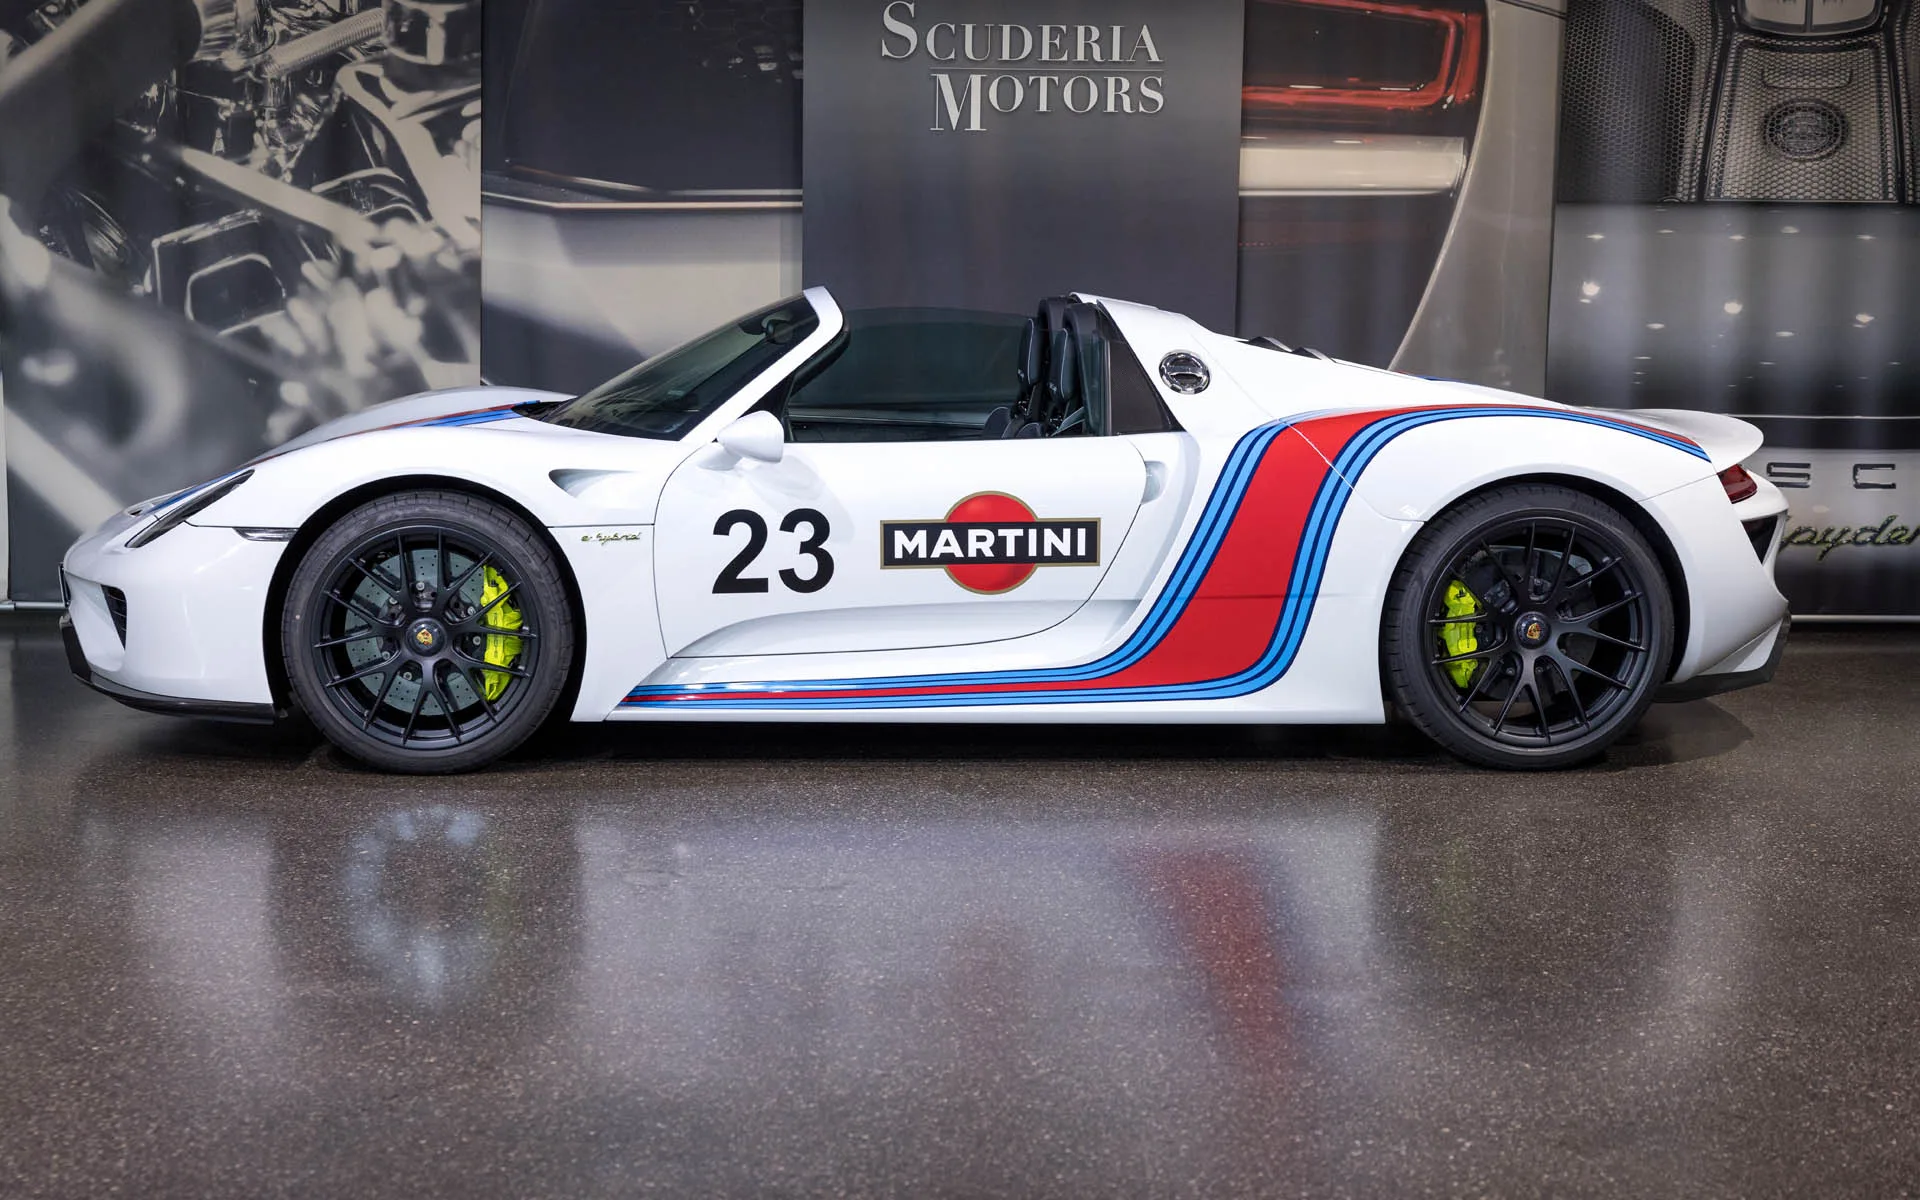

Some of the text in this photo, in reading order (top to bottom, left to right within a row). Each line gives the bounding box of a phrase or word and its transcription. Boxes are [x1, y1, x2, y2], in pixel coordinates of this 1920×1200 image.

[881, 1, 1164, 60] SCUDERIA
[930, 73, 1164, 132] MOTORS
[711, 508, 835, 595] 23
[893, 527, 1087, 559] MARTINI
[1778, 514, 1920, 562] pyder
